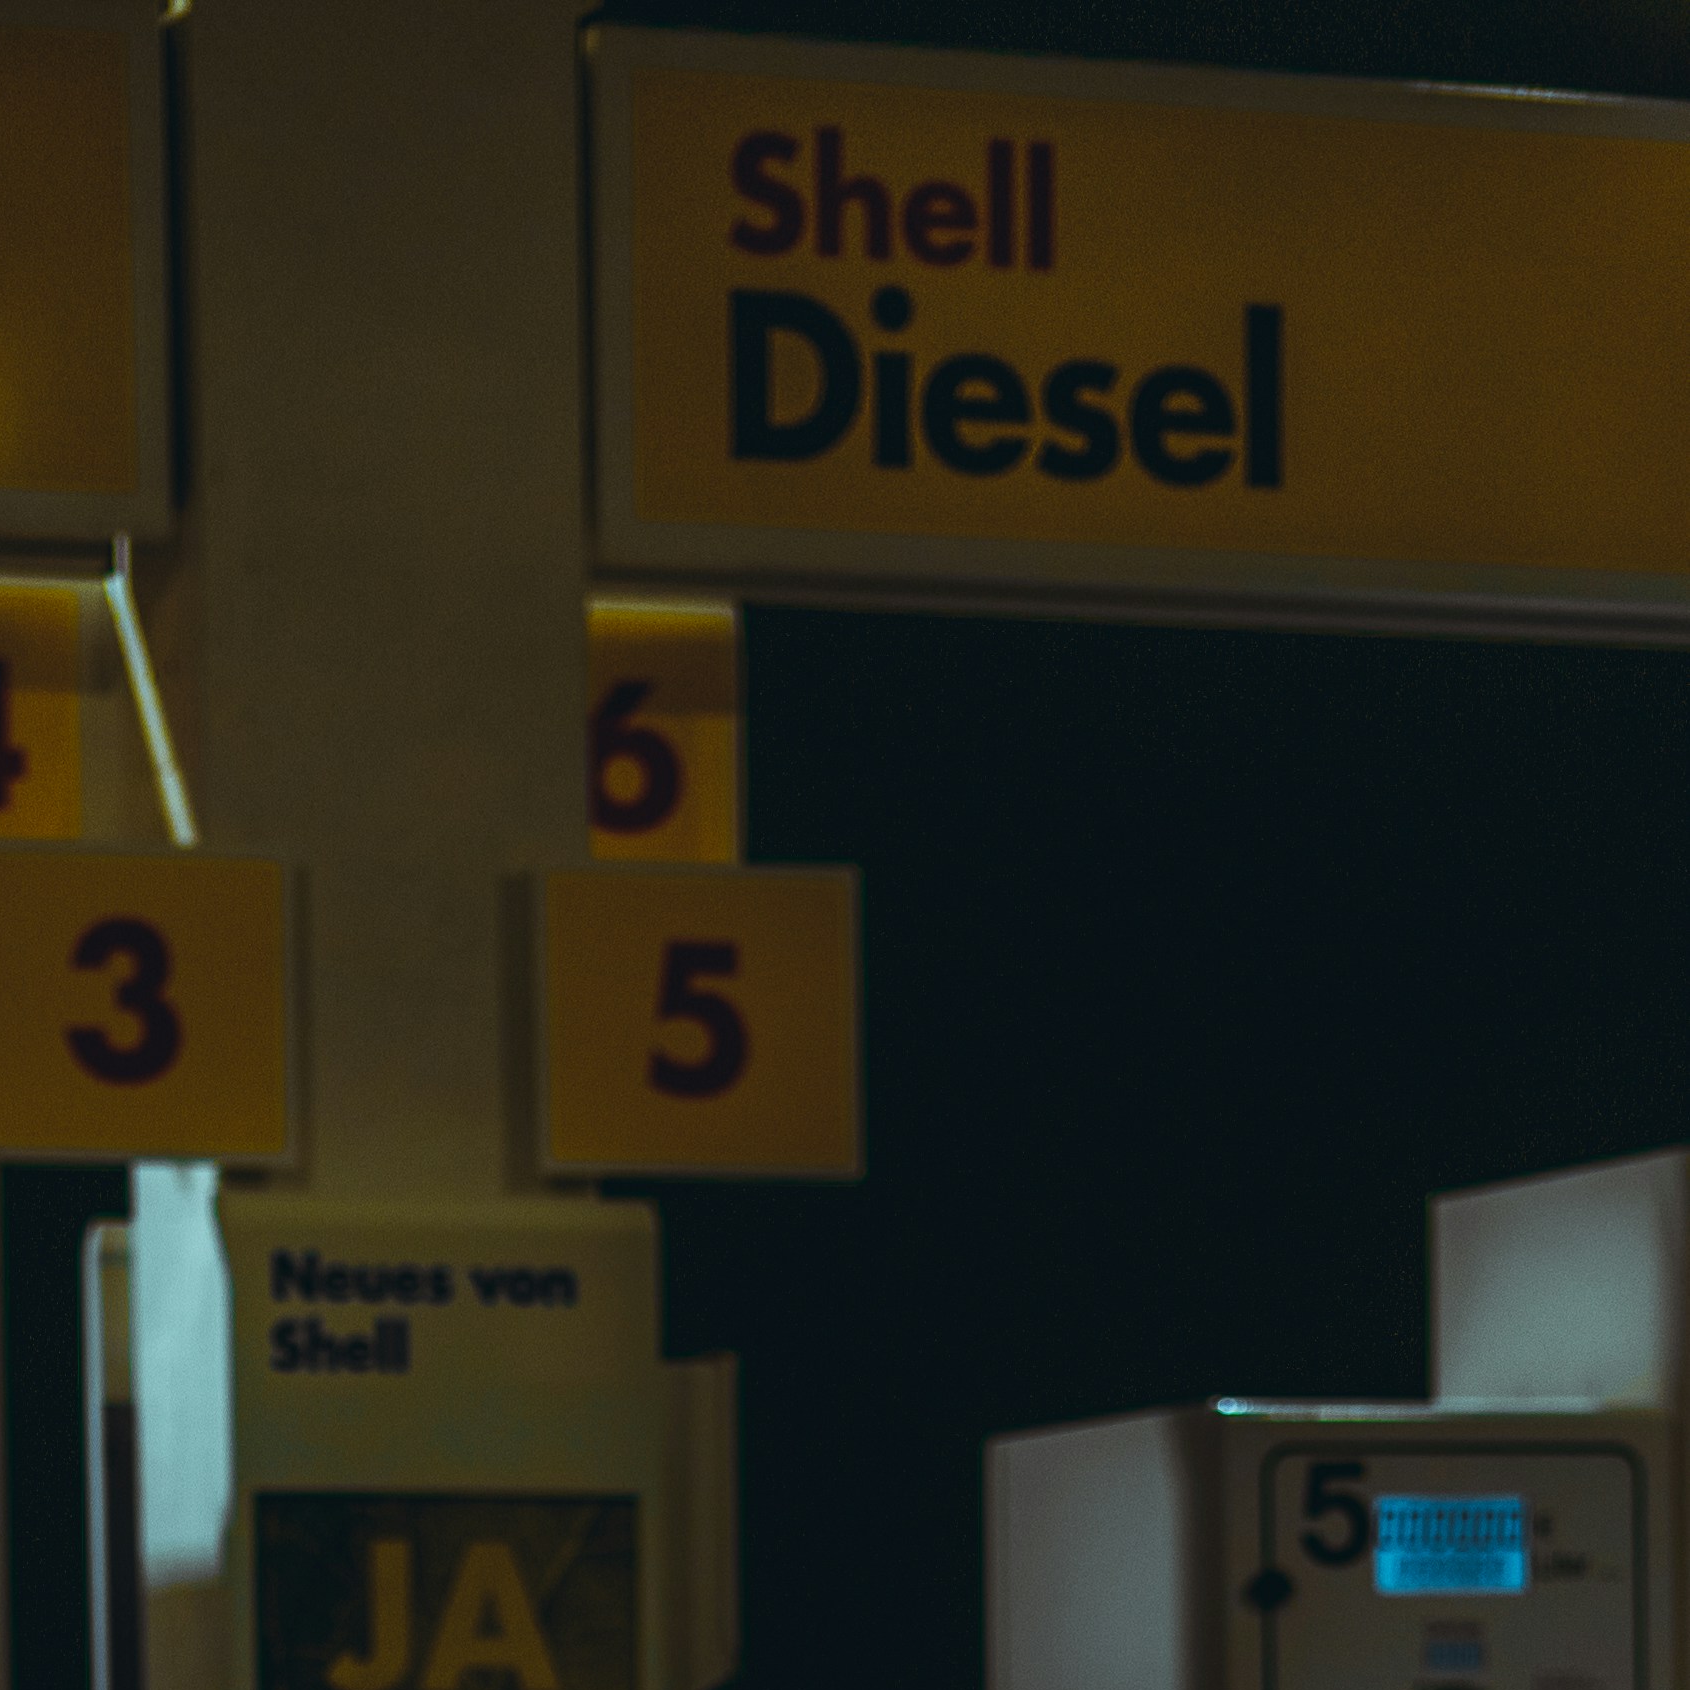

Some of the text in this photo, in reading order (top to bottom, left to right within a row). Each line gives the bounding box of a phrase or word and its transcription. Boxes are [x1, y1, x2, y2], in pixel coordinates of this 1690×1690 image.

[730, 125, 1056, 271] Shell
[730, 286, 1284, 489] Diesel
[587, 679, 686, 834] 6
[63, 915, 186, 1086] 3
[643, 939, 752, 1099] 5
[271, 1248, 579, 1308] Neues von
[271, 1317, 412, 1373] Shell
[1300, 1461, 1371, 1566] 5
